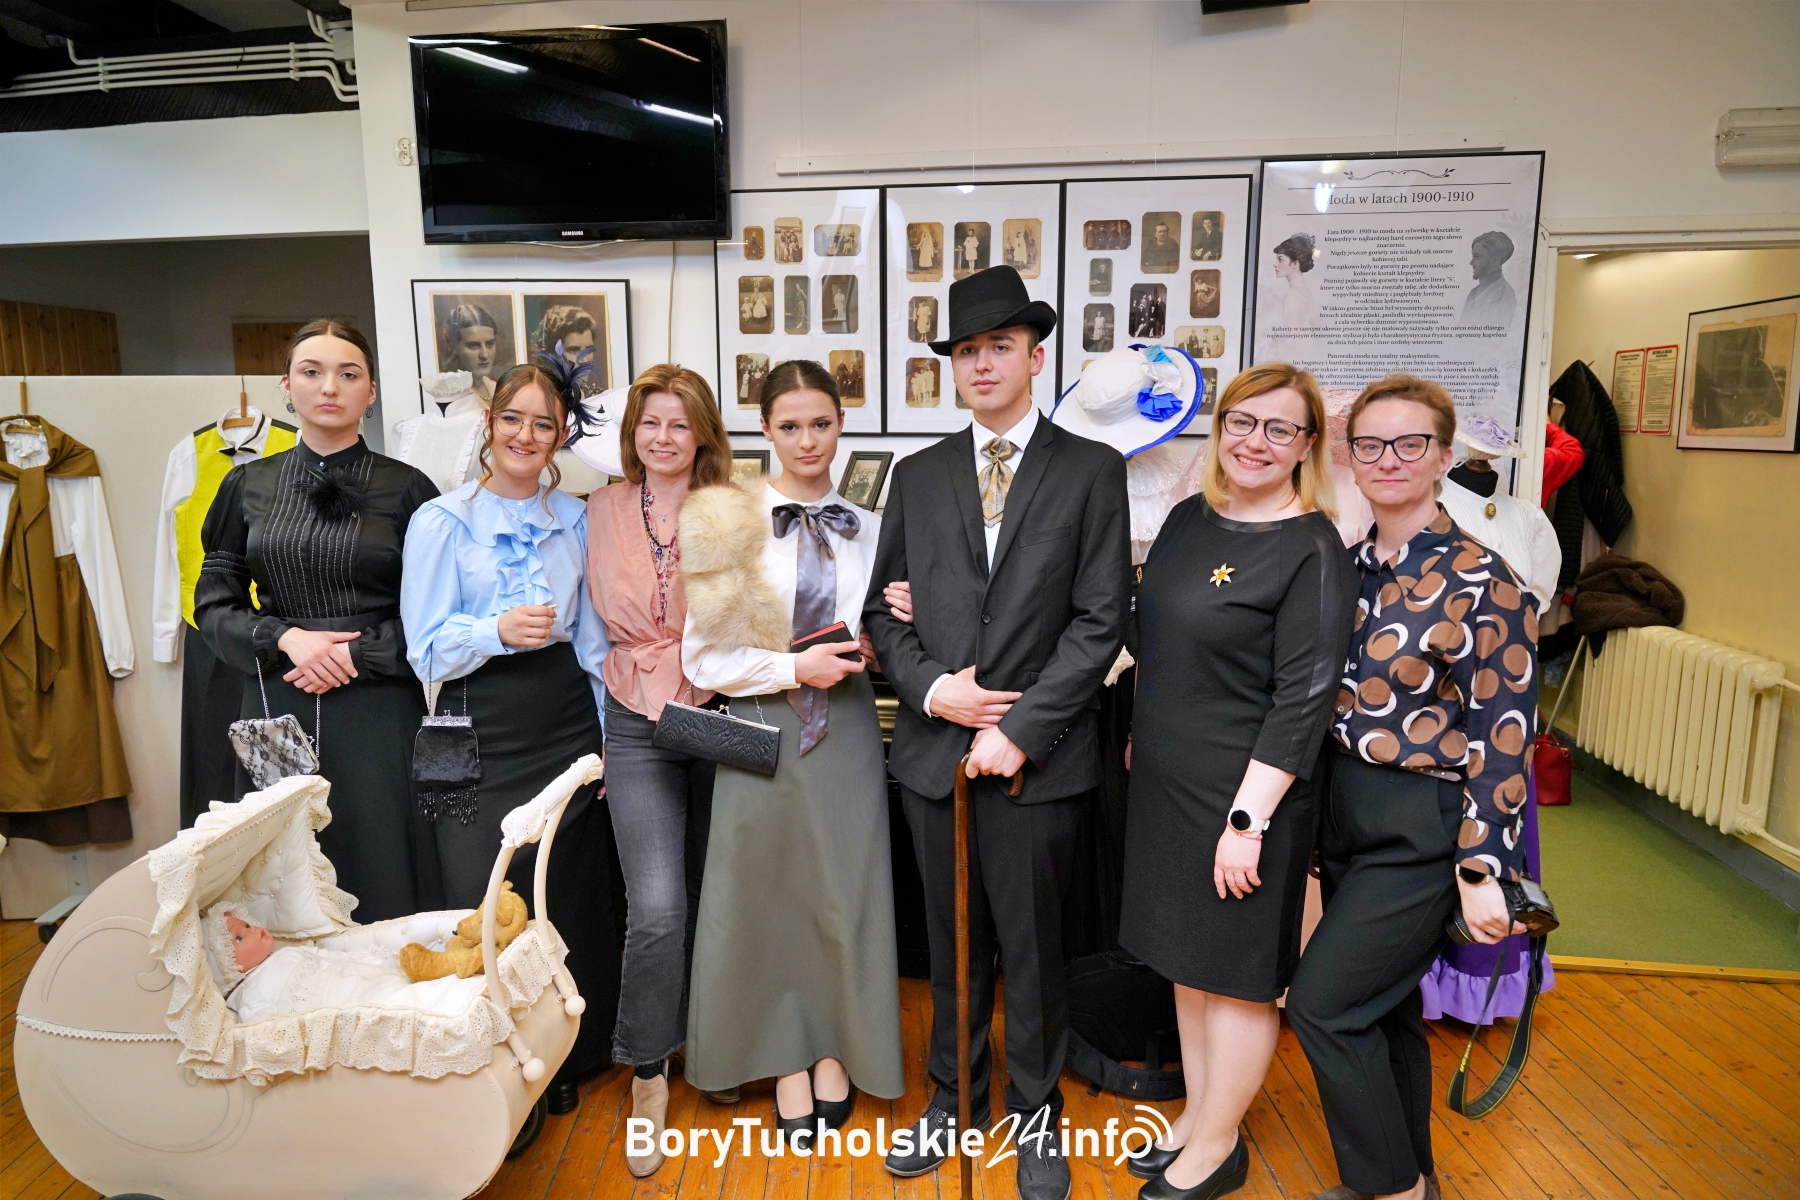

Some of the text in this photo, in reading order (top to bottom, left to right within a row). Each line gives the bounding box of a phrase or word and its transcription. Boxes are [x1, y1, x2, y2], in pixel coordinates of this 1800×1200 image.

[1359, 196, 1369, 204] w
[1371, 192, 1407, 204] latach
[1411, 191, 1474, 203] 1900-1910
